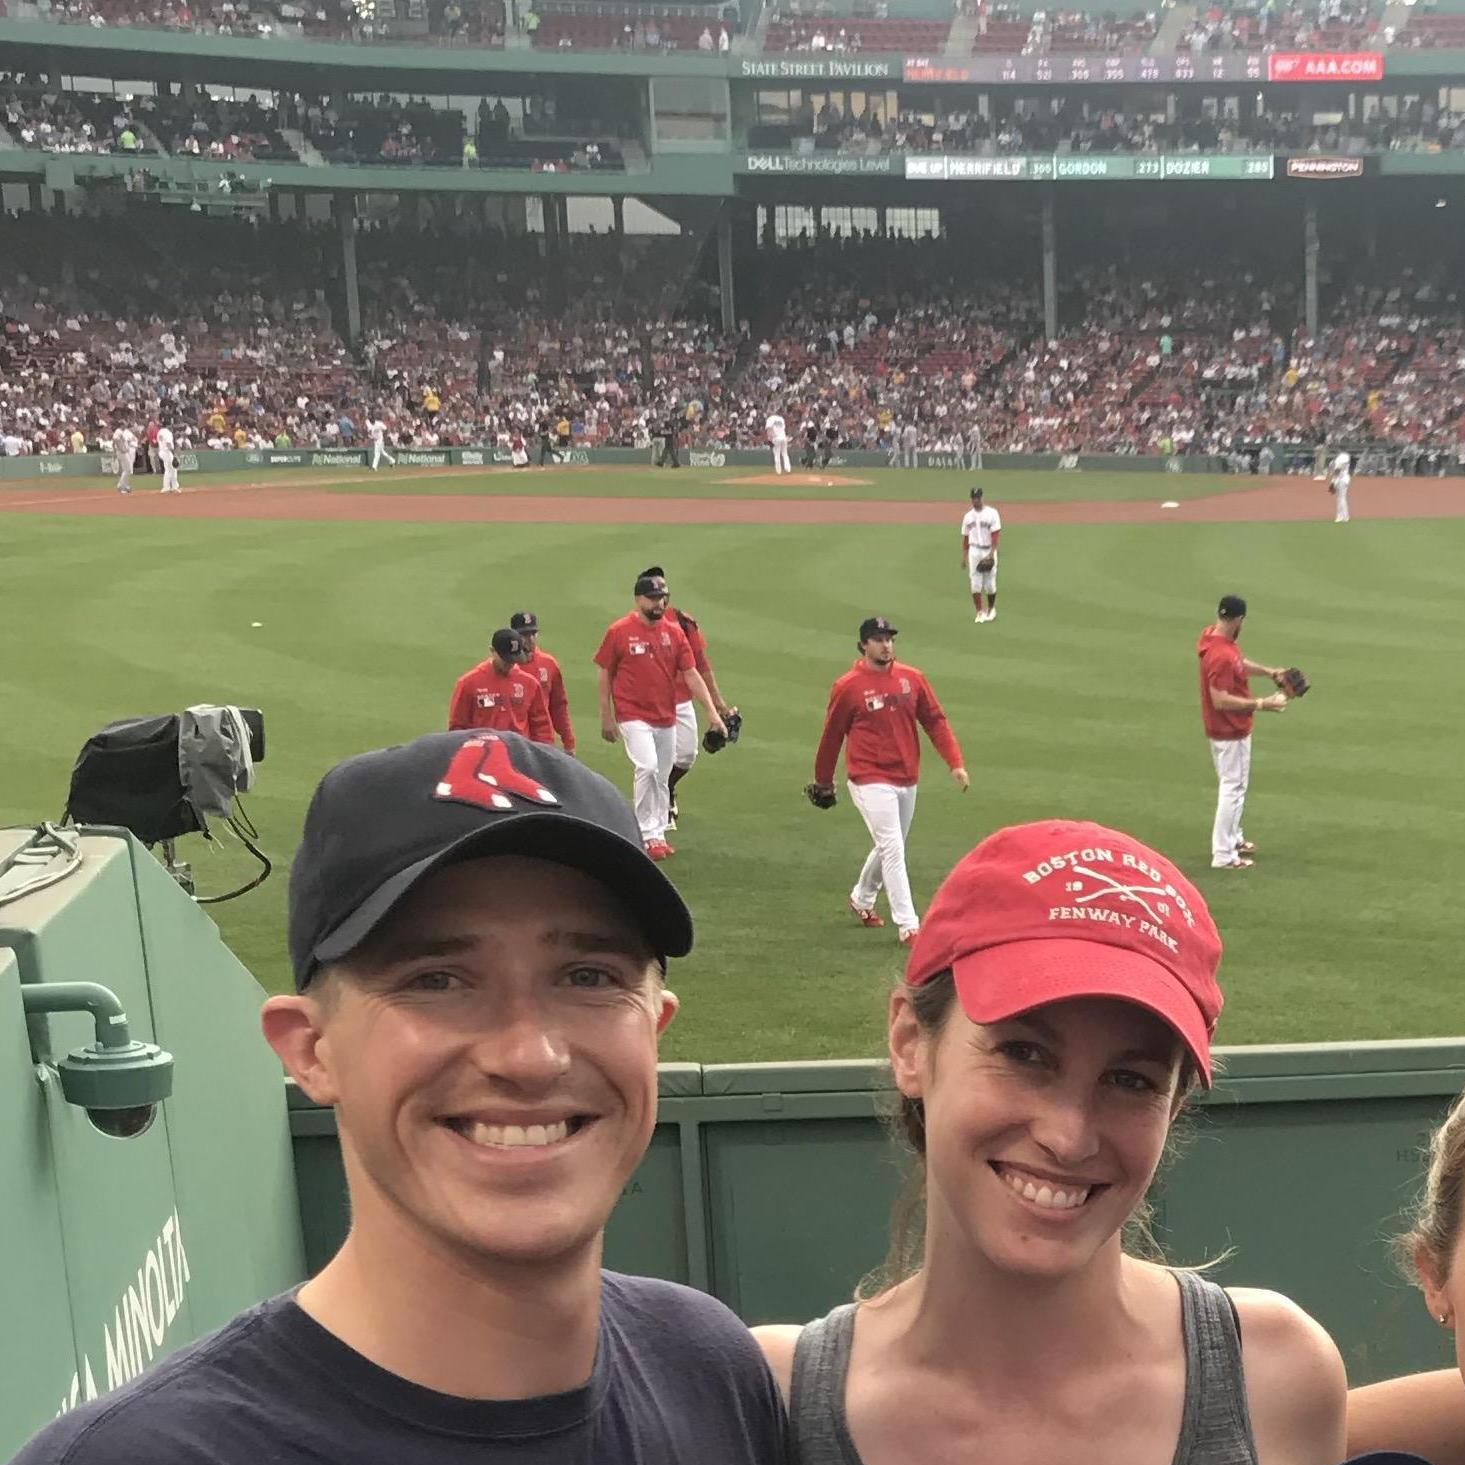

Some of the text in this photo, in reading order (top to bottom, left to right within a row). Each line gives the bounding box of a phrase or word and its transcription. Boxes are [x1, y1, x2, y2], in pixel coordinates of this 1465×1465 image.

[742, 61, 889, 76] STATE STREET PAVILION
[1305, 60, 1377, 74] AAA.COM
[860, 157, 890, 170] Level
[950, 160, 1020, 176] MERRIFIELD
[1058, 160, 1107, 175] GORDON
[1166, 159, 1210, 175] DOZIER
[1022, 847, 1196, 928] BOSTON RED SOX
[1049, 907, 1179, 954] FENWAY PARK
[104, 1205, 190, 1392] MINOLTA
